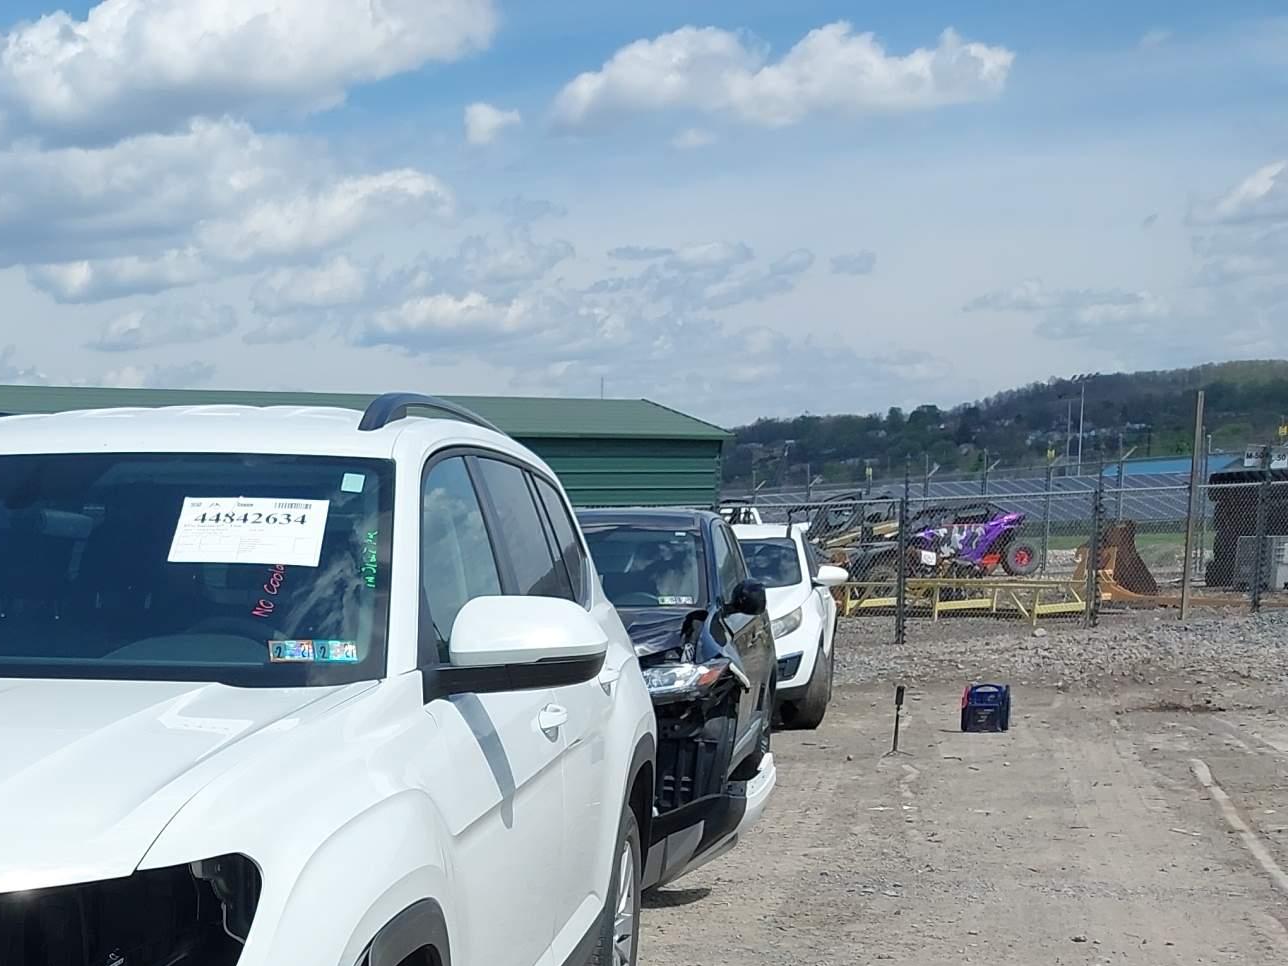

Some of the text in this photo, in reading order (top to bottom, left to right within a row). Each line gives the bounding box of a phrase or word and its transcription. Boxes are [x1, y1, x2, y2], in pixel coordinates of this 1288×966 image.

[194, 511, 307, 525] 44842634
[252, 564, 285, 617] NO Coola
